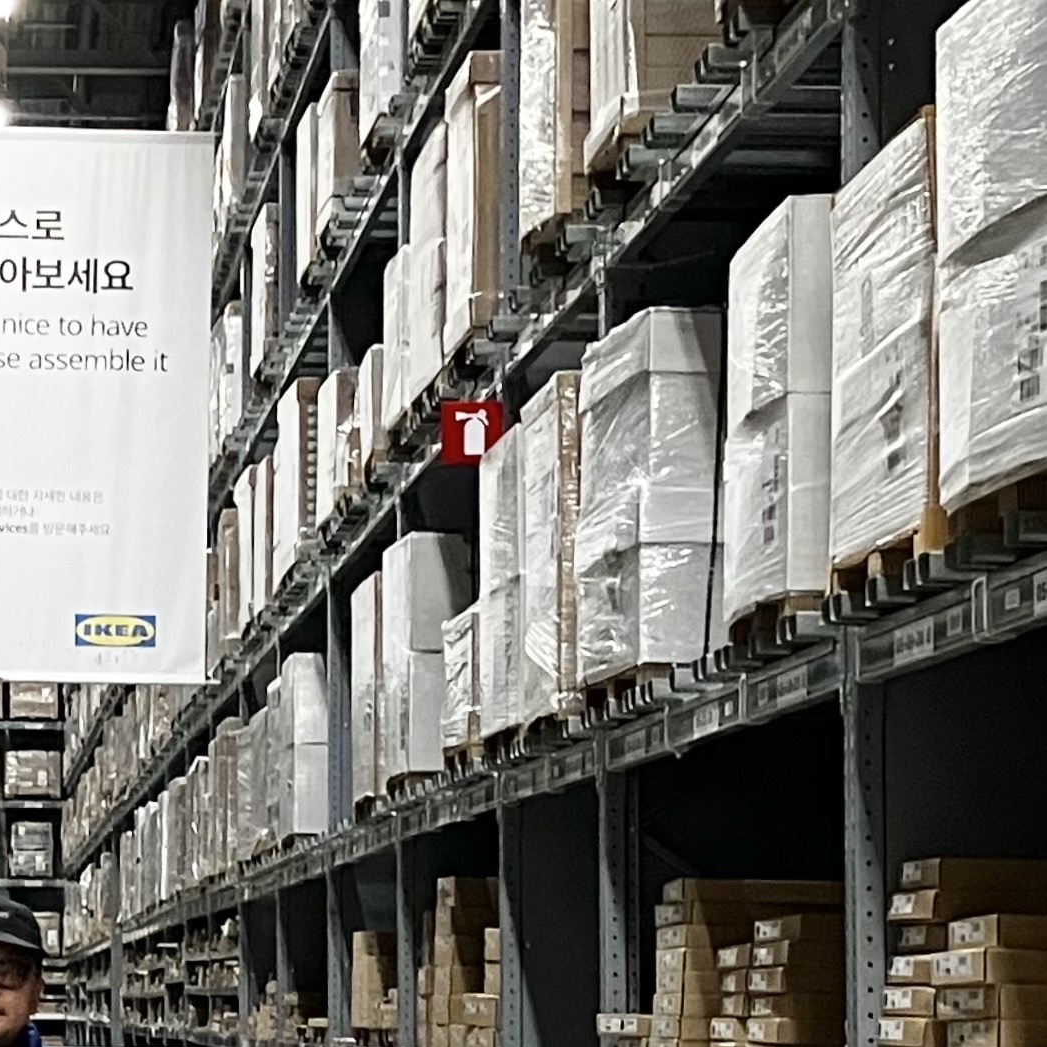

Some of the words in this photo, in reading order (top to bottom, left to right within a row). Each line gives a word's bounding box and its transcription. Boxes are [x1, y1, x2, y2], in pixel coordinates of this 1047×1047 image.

[2, 313, 50, 335] nice
[59, 315, 82, 336] to
[91, 314, 148, 338] have
[29, 348, 145, 372] assemble
[154, 350, 168, 373] it
[83, 624, 149, 638] IKEA
